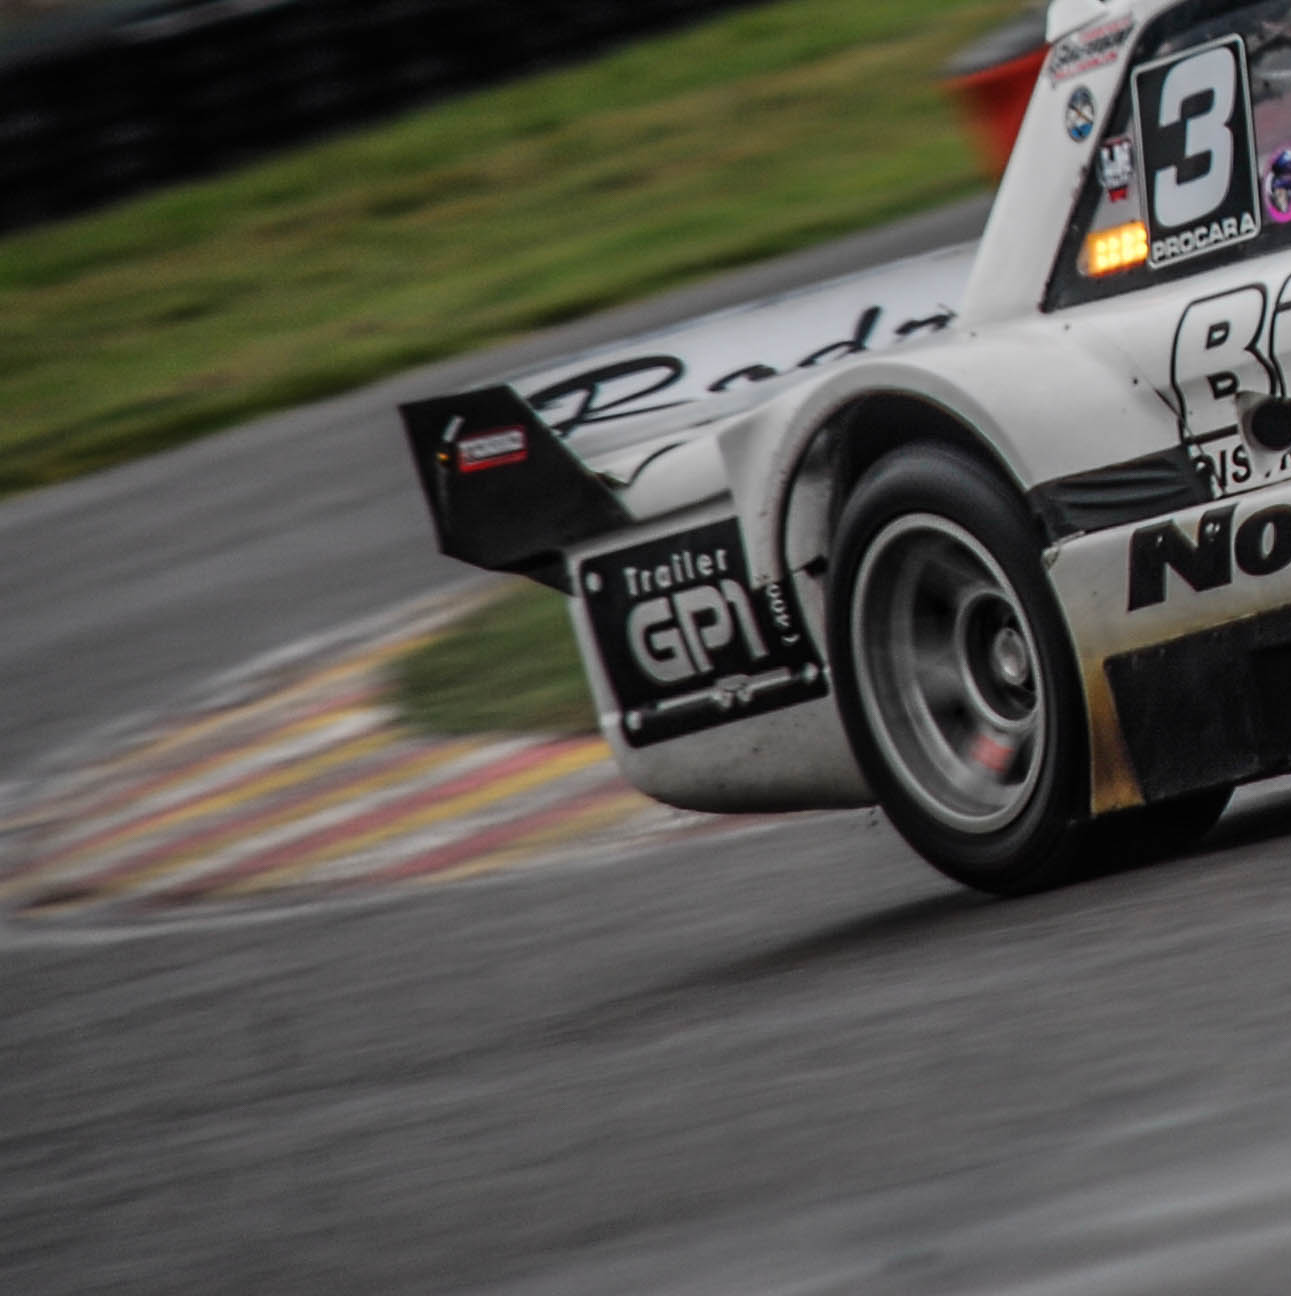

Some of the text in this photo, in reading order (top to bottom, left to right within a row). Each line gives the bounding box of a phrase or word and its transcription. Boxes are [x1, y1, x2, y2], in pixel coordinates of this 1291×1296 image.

[1153, 46, 1238, 228] 3
[1151, 211, 1257, 263] PROCARA
[623, 548, 729, 596] Trailer
[626, 579, 769, 684] GP1
